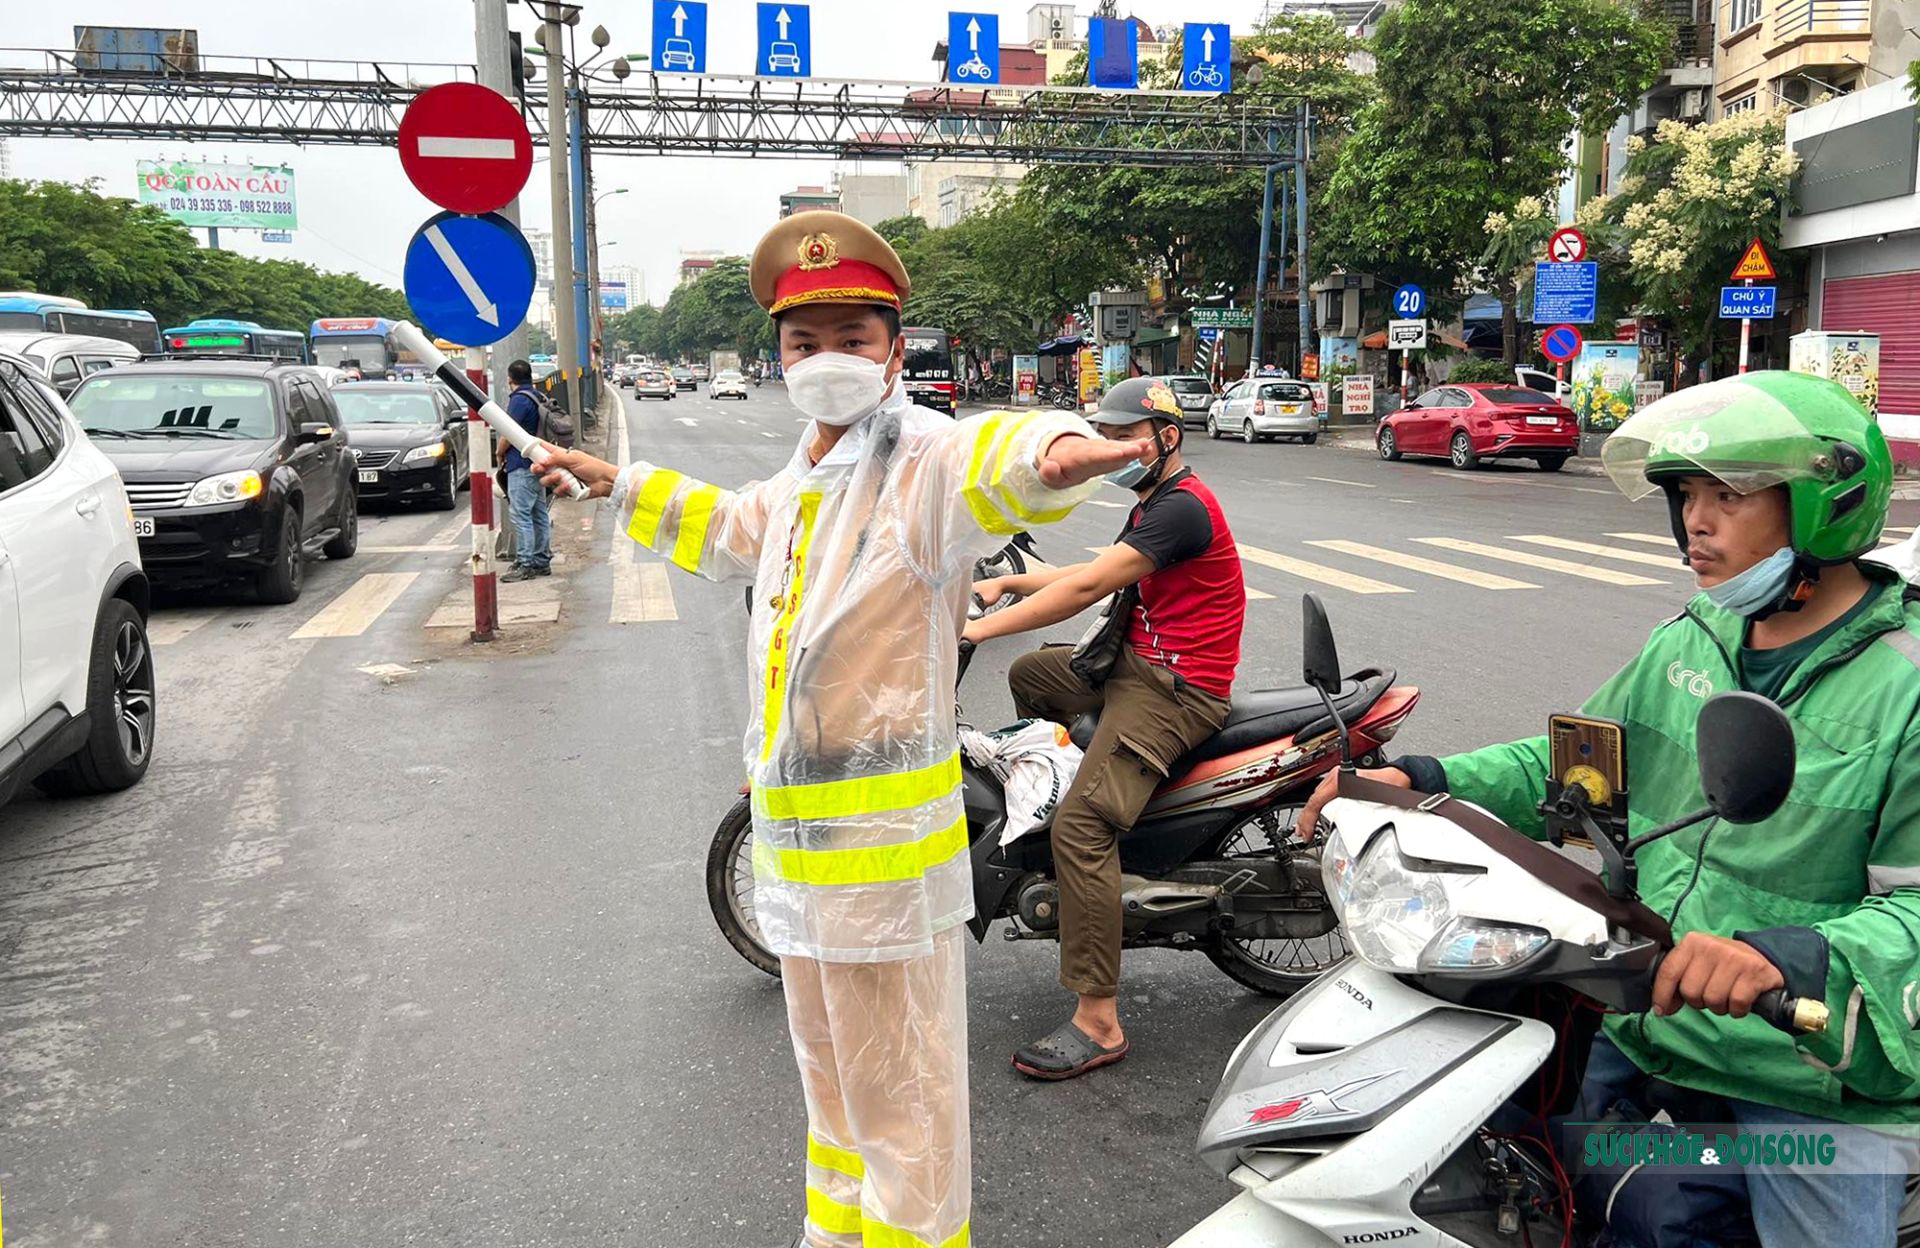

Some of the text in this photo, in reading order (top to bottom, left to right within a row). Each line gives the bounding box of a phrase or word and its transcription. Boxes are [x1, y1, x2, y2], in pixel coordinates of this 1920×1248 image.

[146, 174, 176, 192] QC
[182, 172, 242, 193] TOÀN
[170, 197, 186, 211] 024
[187, 198, 199, 211] 39
[200, 199, 216, 212] 335
[217, 199, 233, 213] 336
[239, 200, 255, 213] 098
[256, 201, 272, 214] 522
[273, 201, 292, 215] 8888
[1399, 290, 1420, 313] 20
[1732, 289, 1766, 302] CHÚ Ý
[1722, 303, 1772, 315] QUAN SÁT
[134, 520, 152, 535] 86
[1343, 1225, 1420, 1245] HONDA
